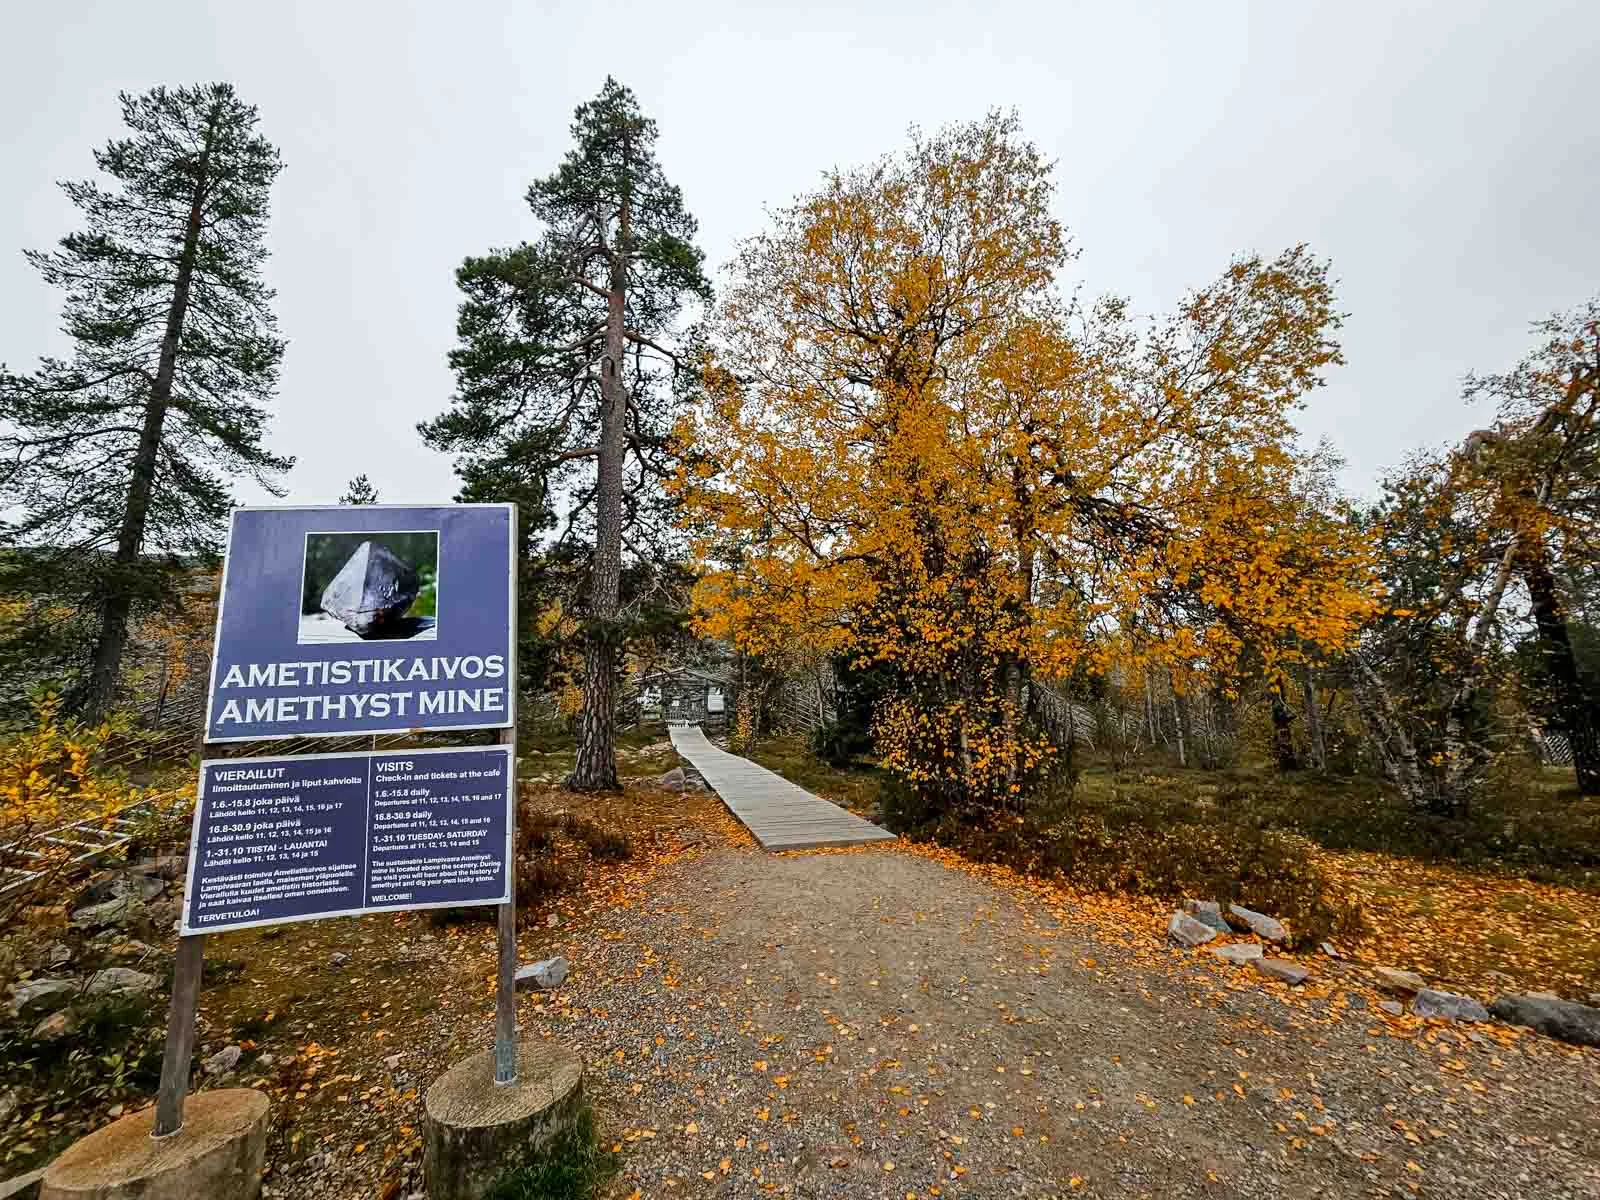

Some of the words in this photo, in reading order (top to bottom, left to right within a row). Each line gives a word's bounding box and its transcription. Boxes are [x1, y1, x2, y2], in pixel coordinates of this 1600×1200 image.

[219, 655, 505, 689] AMETISTIKAIVOS
[215, 692, 412, 724] AMETHYST
[418, 688, 504, 716] MINE
[377, 761, 414, 771] VISITS
[214, 768, 285, 781] VIERAILUT
[376, 774, 412, 782] Check-in
[430, 771, 458, 779] tickets
[469, 770, 482, 778] the
[212, 781, 290, 793] Ilmoittautuminen
[291, 780, 300, 789] ja
[302, 778, 322, 788] liput
[375, 790, 409, 798] 1.6.-15.8
[410, 788, 430, 797] daily
[211, 799, 250, 809] 1.6.-15.8
[252, 798, 273, 808] joka
[275, 796, 300, 805] päivä
[374, 799, 410, 807] Departures
[209, 810, 237, 818] Lähdöt
[237, 808, 256, 816] kello
[412, 811, 433, 820] daily
[252, 822, 274, 832] joka
[275, 819, 301, 830] päivä
[207, 835, 234, 843] Lähdöt
[235, 833, 254, 841] kello
[374, 834, 406, 844] 1.-31.10
[447, 830, 488, 839] SATURDAY
[206, 847, 244, 858] 1.-31.10
[284, 840, 328, 851] LAUANTAI
[204, 859, 231, 867] Lähdöt
[480, 860, 501, 868] During
[399, 873, 412, 881] you
[416, 879, 427, 887] dig
[458, 876, 475, 884] lucky
